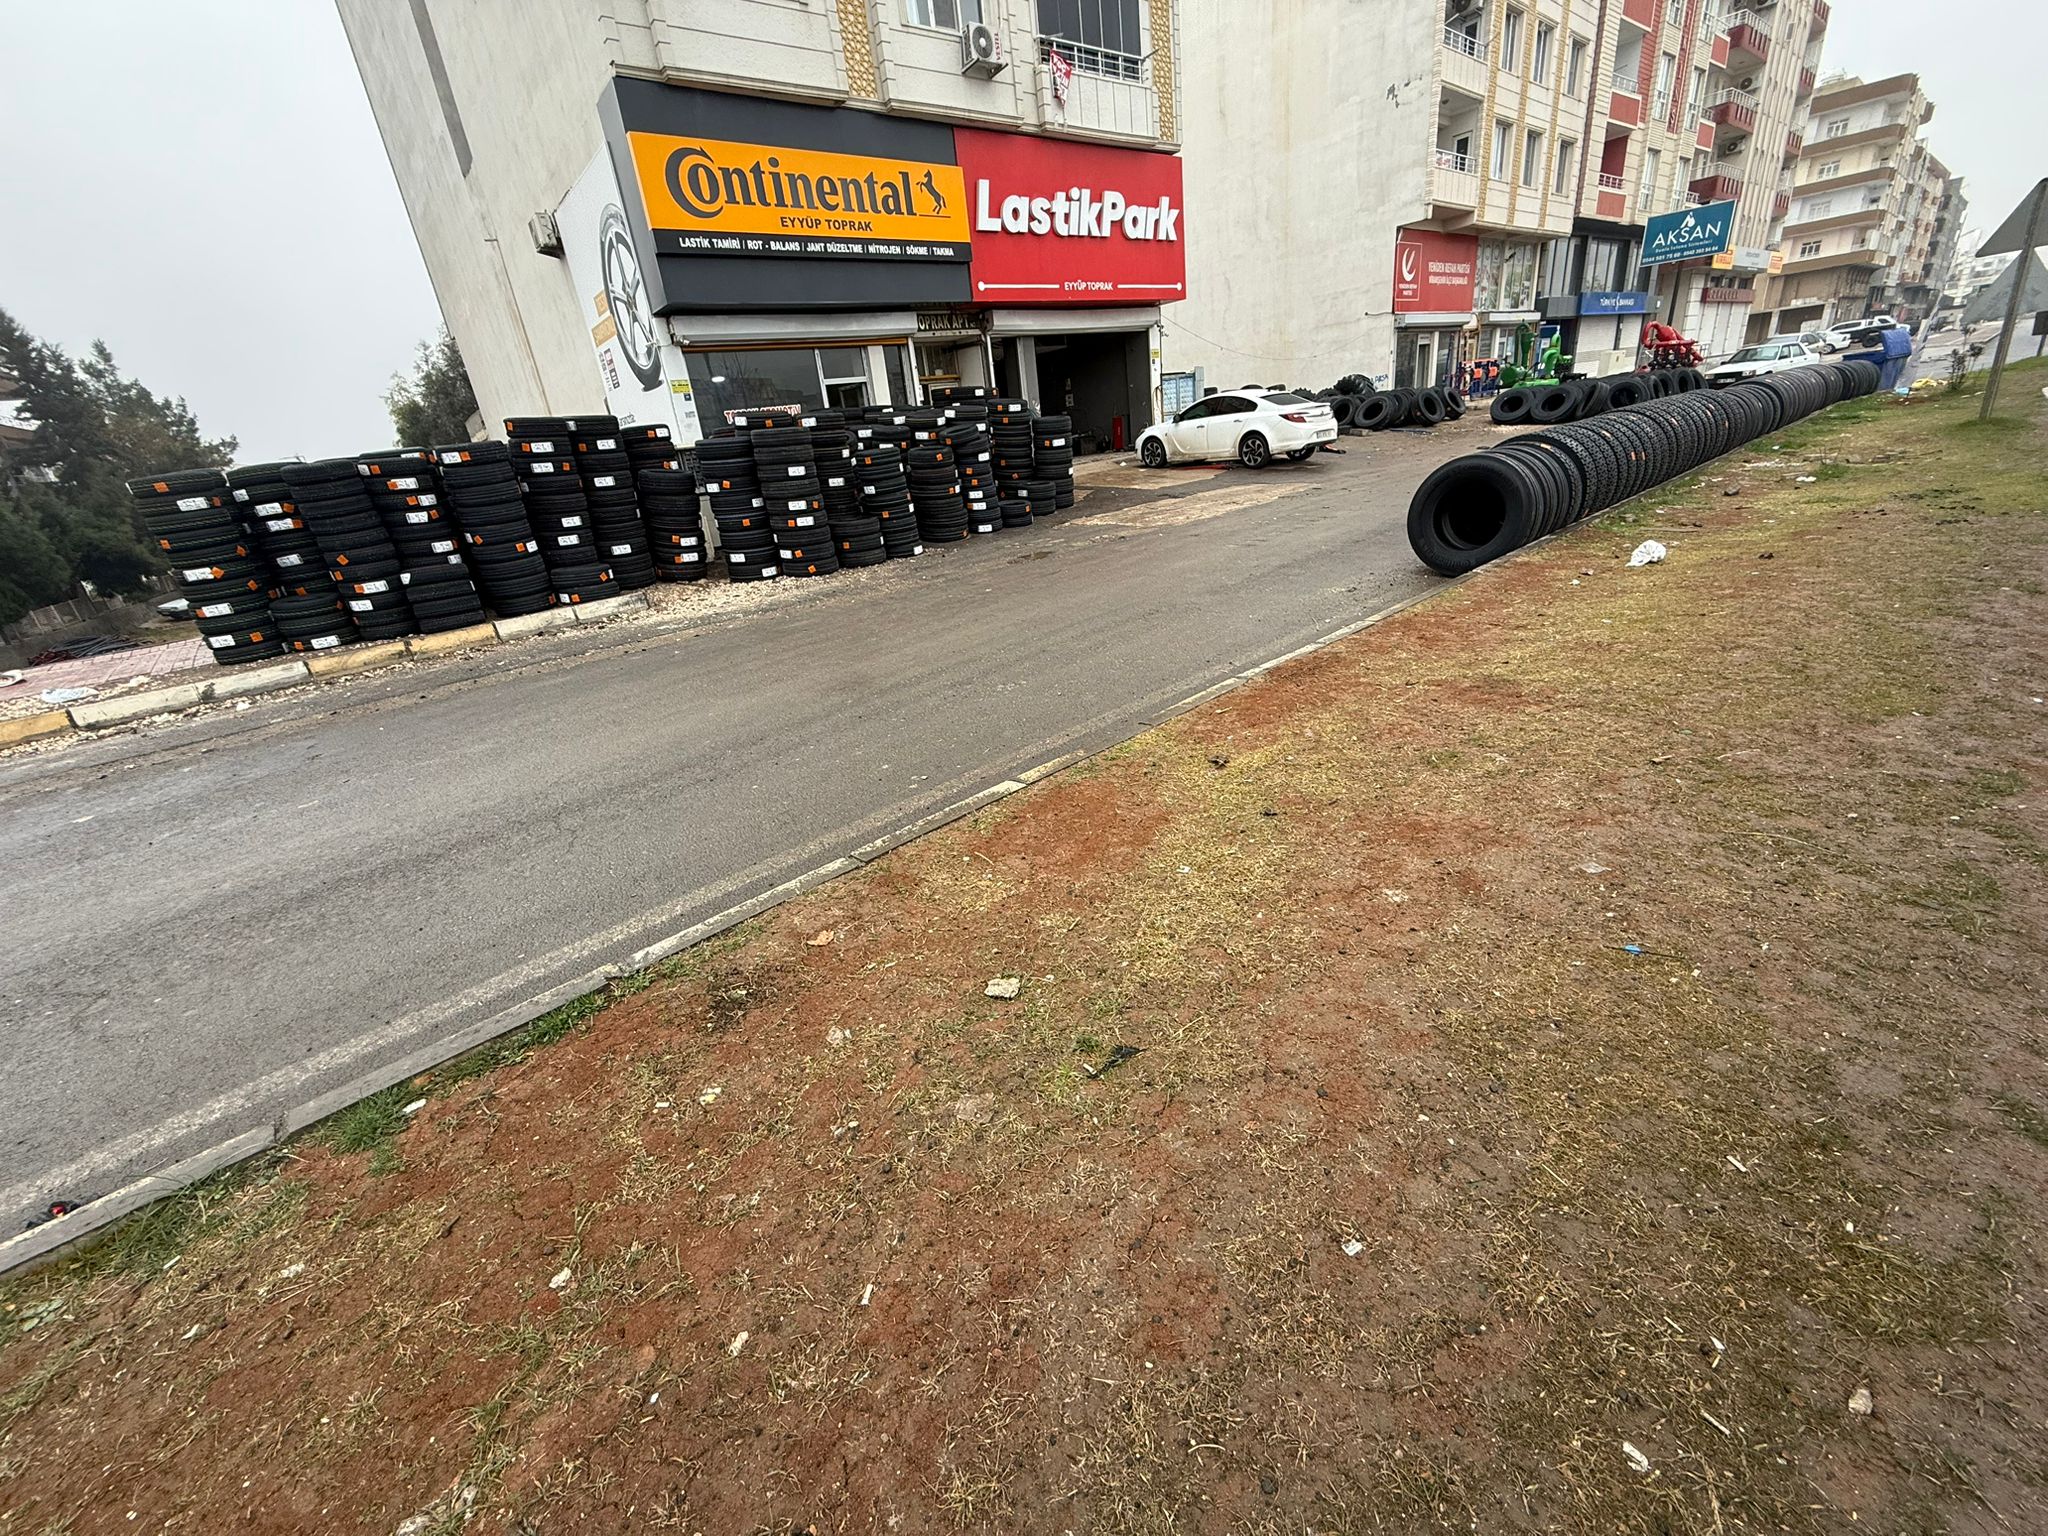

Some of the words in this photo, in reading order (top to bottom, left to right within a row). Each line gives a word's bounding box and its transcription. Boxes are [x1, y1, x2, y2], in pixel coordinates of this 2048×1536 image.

[665, 146, 917, 218] Continental
[976, 178, 1180, 241] LastikPark
[780, 216, 821, 230] EYYÜP
[825, 218, 873, 232] TOPRAK
[1652, 220, 1722, 248] AKSAN
[679, 236, 711, 248] LASTİK
[712, 237, 741, 249] TAMİRİ
[747, 240, 763, 250] ROT
[770, 241, 800, 252] BALANS
[806, 242, 825, 252] JANT
[826, 242, 863, 254] DÜZELTME
[868, 243, 901, 255] NİTROJEN
[906, 245, 929, 256] SÖKME
[933, 247, 954, 256] TAKMA
[1064, 279, 1087, 291] EYYÜP
[1087, 281, 1114, 291] TOPRAK
